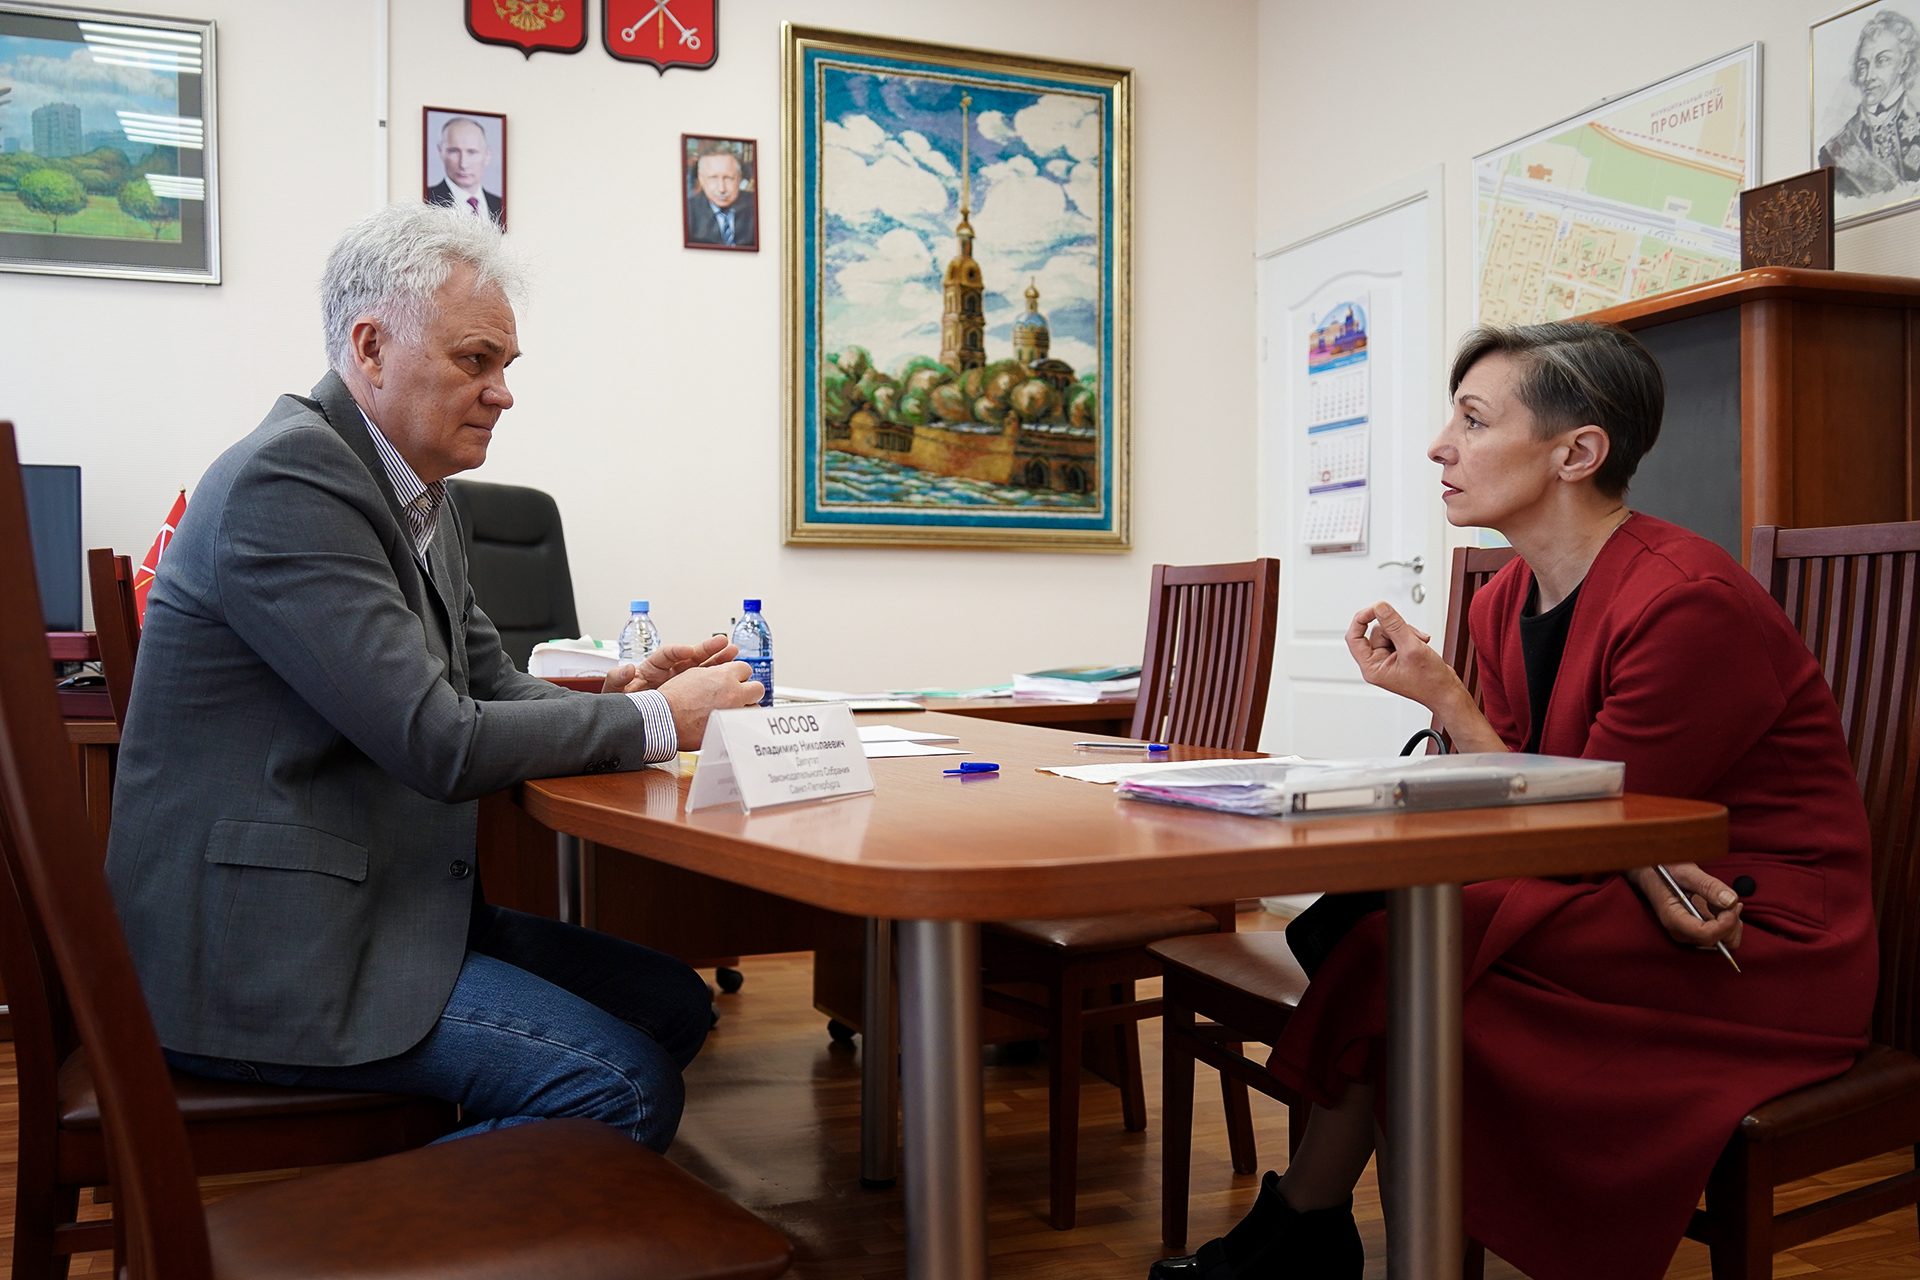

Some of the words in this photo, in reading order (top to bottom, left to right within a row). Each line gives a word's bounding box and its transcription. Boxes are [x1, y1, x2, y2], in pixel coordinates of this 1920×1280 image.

[1651, 93, 1723, 135] ПРОМЕТЕЙ
[767, 715, 819, 735] НОСОВ
[754, 744, 799, 756] Владимир
[799, 740, 846, 752] Николаевич
